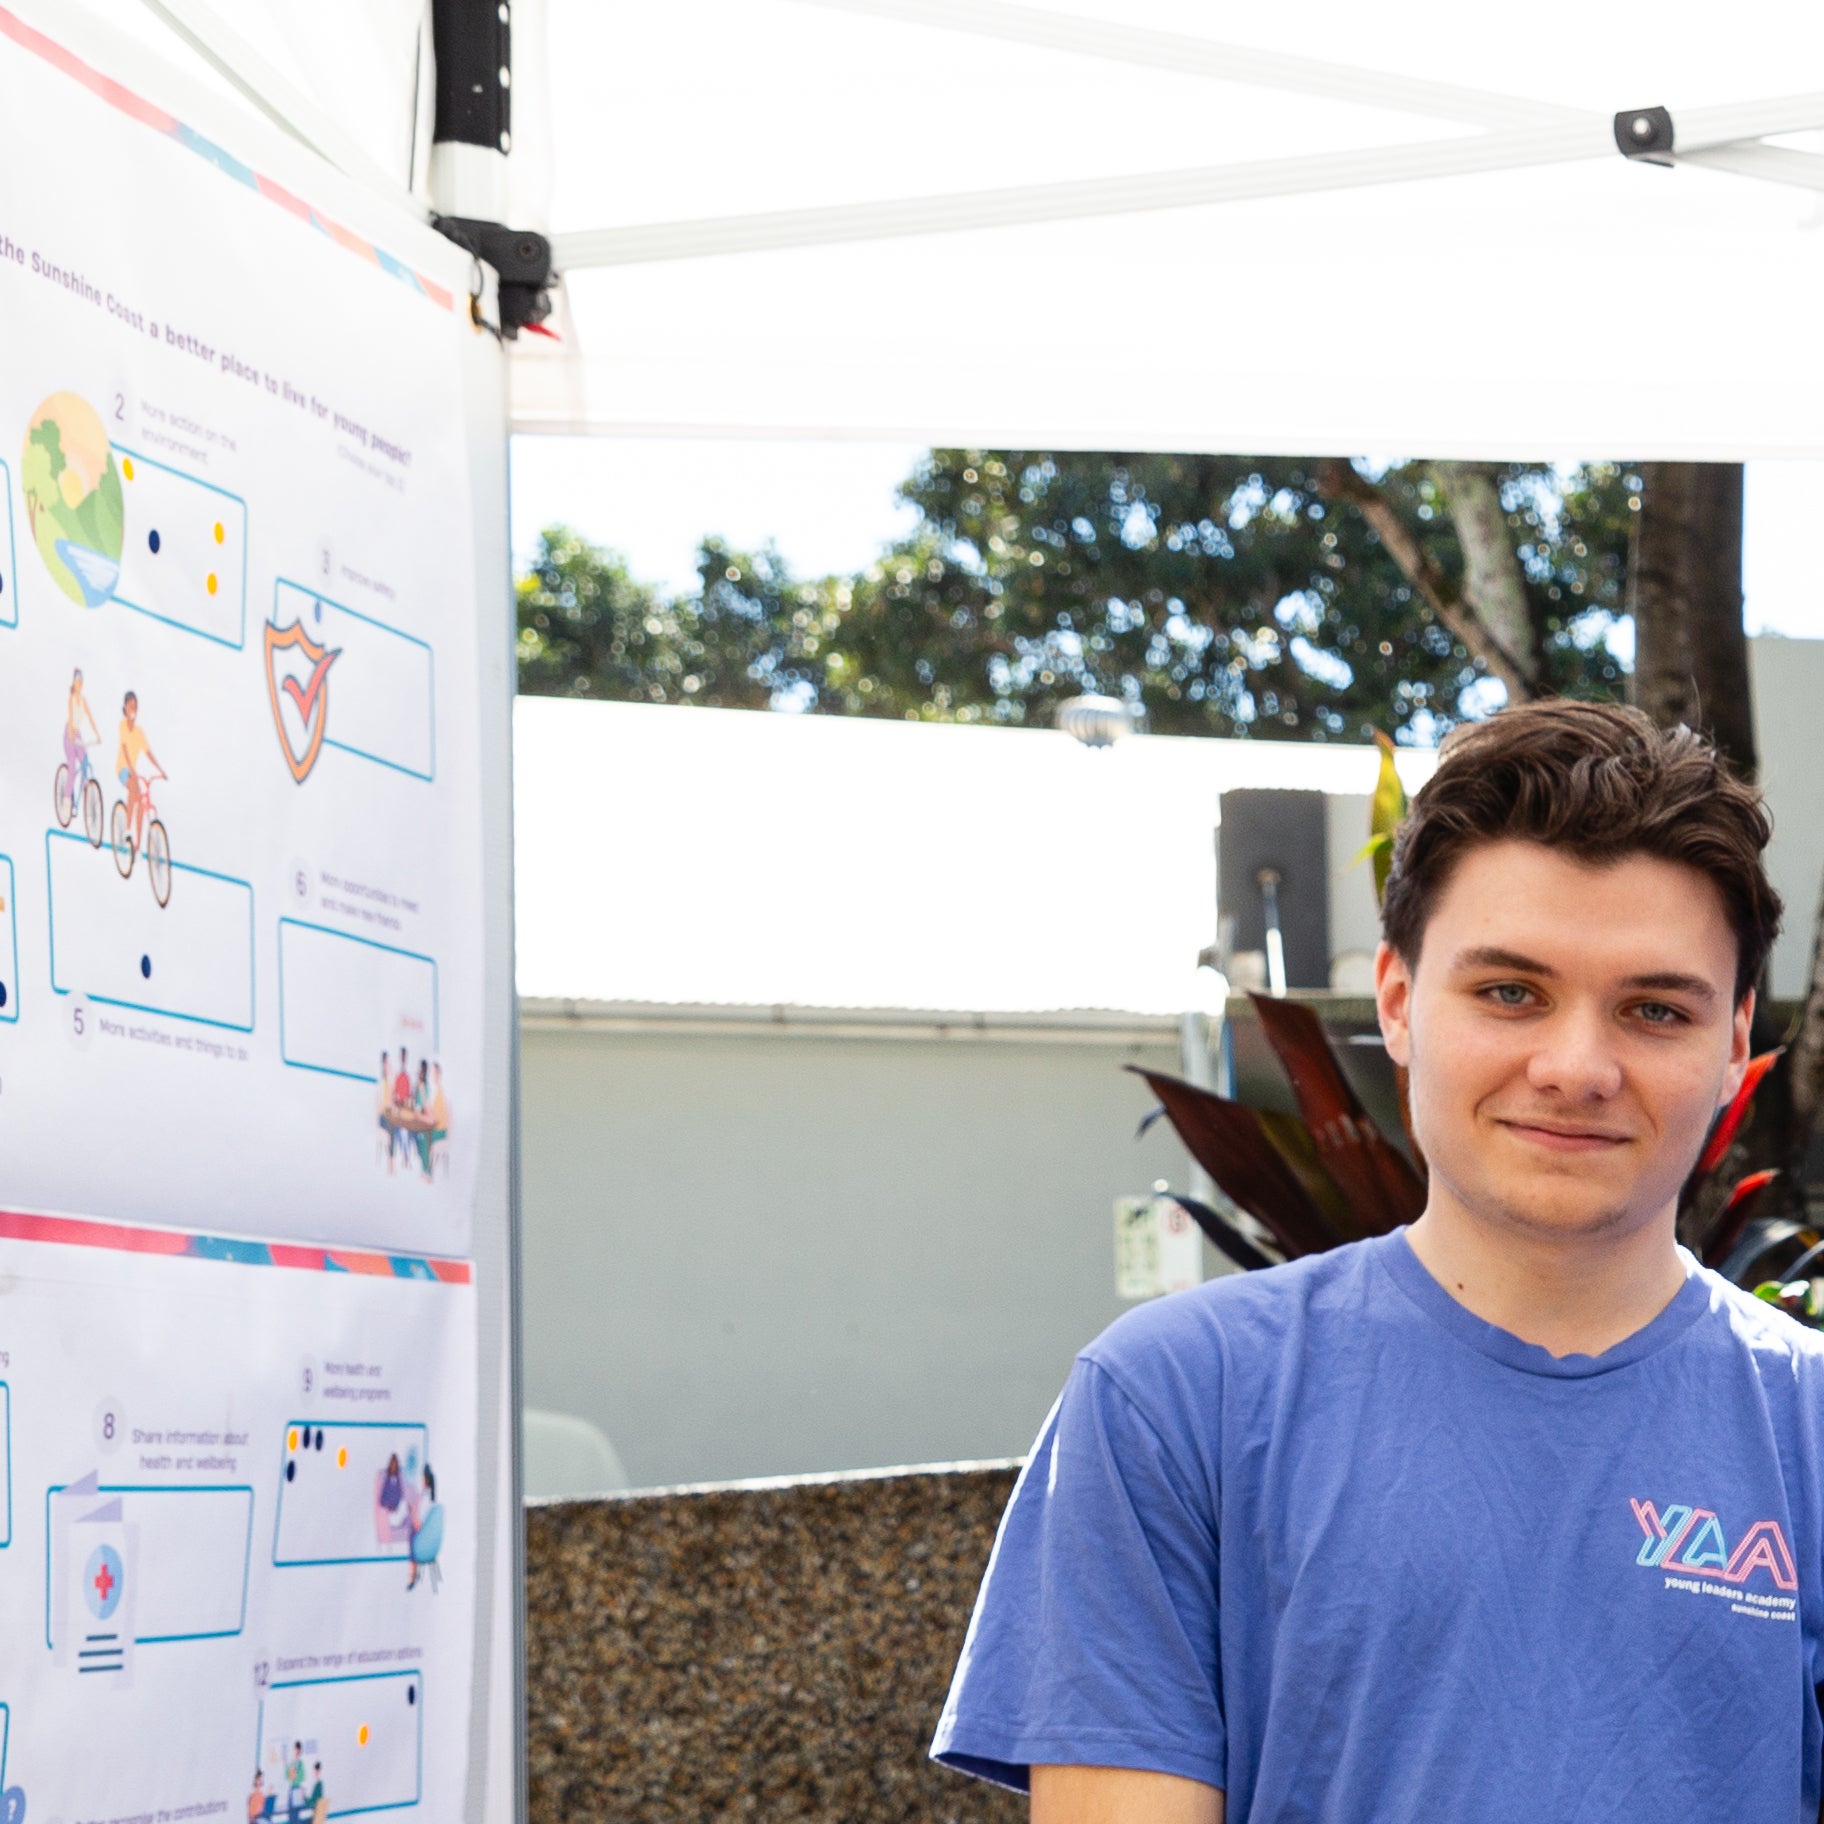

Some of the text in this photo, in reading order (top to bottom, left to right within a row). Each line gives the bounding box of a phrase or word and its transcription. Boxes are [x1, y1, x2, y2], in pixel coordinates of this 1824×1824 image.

[0, 234, 25, 265] the
[32, 252, 102, 305] Sunshine
[106, 293, 146, 331] Coast
[149, 321, 160, 339] a
[166, 327, 216, 361] better
[221, 355, 260, 386] place
[264, 374, 279, 396] to
[114, 394, 125, 421] 2
[1664, 1576, 1796, 1610] young leaders academy
